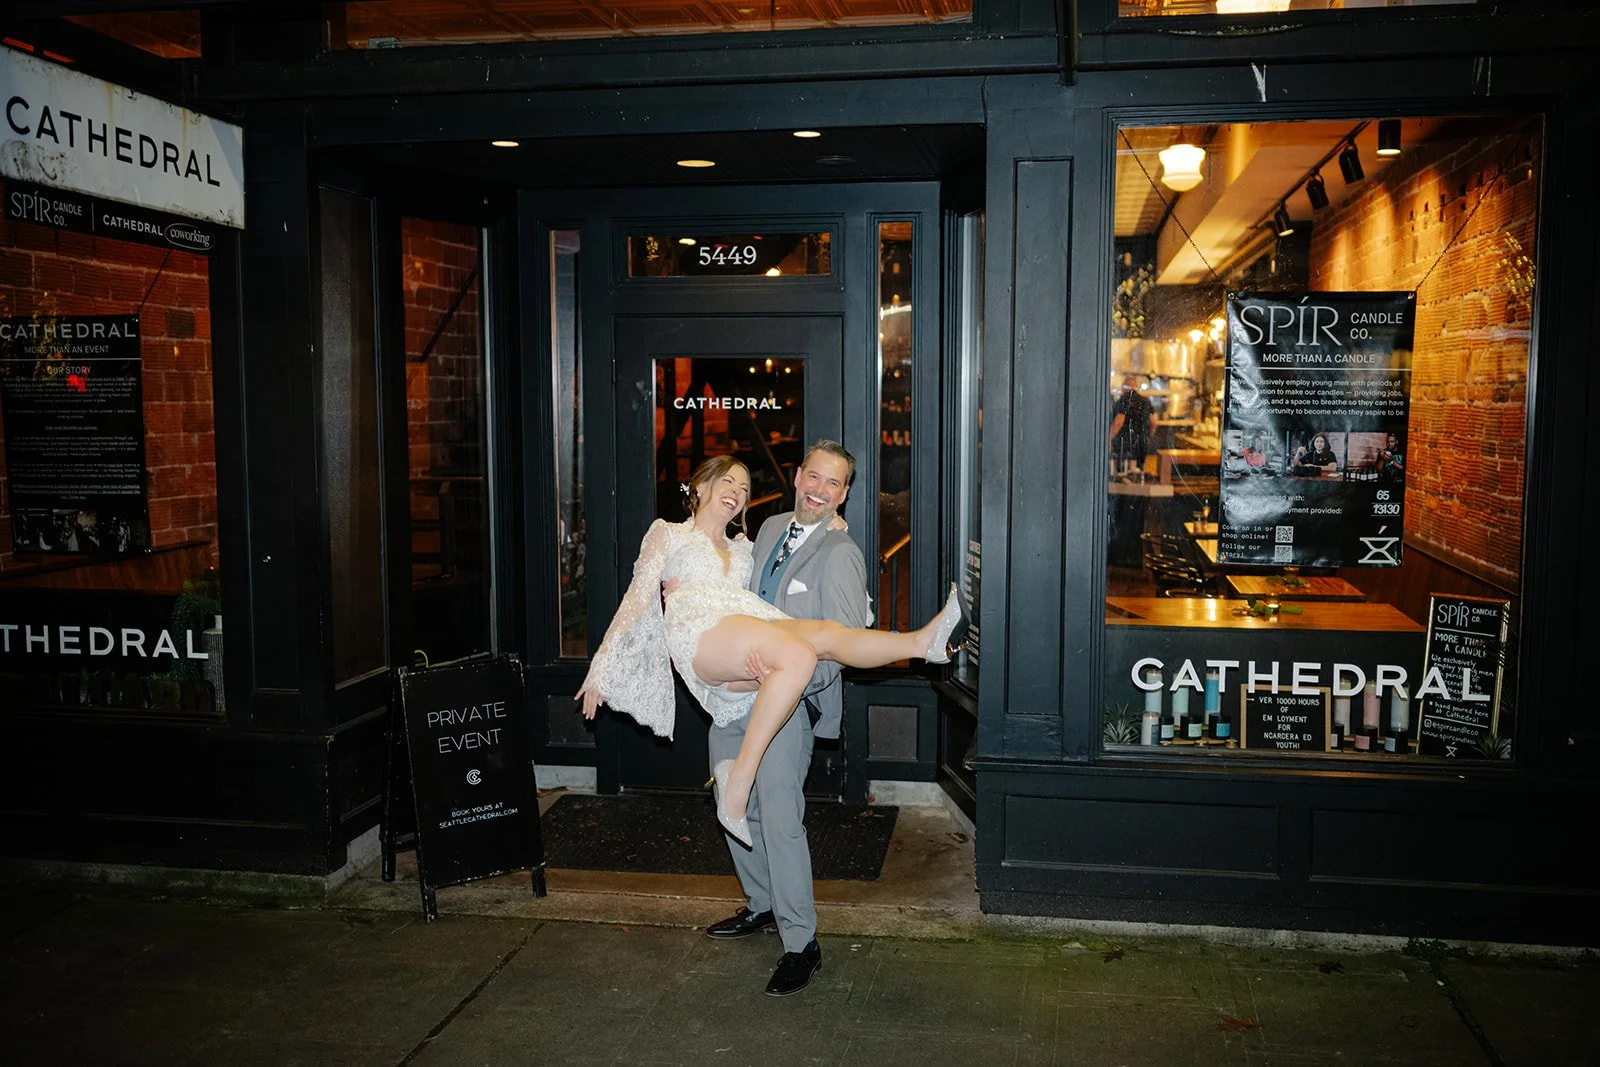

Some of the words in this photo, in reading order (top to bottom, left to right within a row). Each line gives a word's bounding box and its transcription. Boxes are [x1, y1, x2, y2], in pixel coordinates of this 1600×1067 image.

[5, 96, 220, 187] CATHEDRAL
[11, 191, 52, 223] SPÍR
[53, 200, 82, 216] CANDLE
[54, 215, 67, 227] CO.
[102, 214, 163, 236] CATHEDRAL
[170, 228, 211, 247] coworking
[699, 245, 757, 265] 5449
[1239, 296, 1342, 346] SPÍR
[1351, 313, 1403, 325] CANDLE
[0, 323, 137, 339] CATHEDRAL
[1350, 328, 1373, 340] CO.
[24, 346, 47, 354] MORE
[48, 346, 70, 354] THAN
[85, 345, 110, 353] EVENT
[1263, 353, 1292, 363] MORE
[1297, 354, 1323, 363] THAN
[1324, 354, 1333, 363] A
[1334, 354, 1375, 364] CANDLE
[66, 366, 92, 375] STORY
[1286, 378, 1311, 387] employ
[1312, 380, 1333, 388] young
[1317, 388, 1344, 396] candles
[1354, 389, 1386, 397] providing
[673, 397, 782, 410] CATHEDRAL
[1291, 399, 1311, 407] space
[1348, 409, 1363, 417] they
[1376, 490, 1390, 500] 65
[1310, 507, 1343, 515] provided:
[1373, 503, 1400, 514] 13130
[1221, 542, 1245, 550] Follow
[1437, 601, 1470, 627] SPÍR
[1472, 607, 1498, 617] CANDLE
[0, 624, 209, 660] THEDRAL
[1435, 632, 1459, 643] MORE
[1444, 643, 1450, 652] A
[1431, 653, 1442, 662] We
[1443, 657, 1477, 669] exclusively
[1131, 657, 1491, 702] CATHEDRAL
[1259, 696, 1273, 704] VER
[1276, 697, 1297, 705] 10000
[1298, 698, 1320, 706] HOURS
[427, 701, 507, 728] PRIVATE
[1434, 701, 1451, 711] hand
[1452, 705, 1473, 714] poured
[1474, 709, 1489, 718] here
[1445, 711, 1479, 723] Cathedral
[438, 728, 501, 753] EVENT
[451, 809, 470, 817] BOOK
[472, 804, 493, 813] YOURS
[495, 801, 504, 809] AT
[439, 808, 519, 829] SEATTLECATHEDRAL.COM
